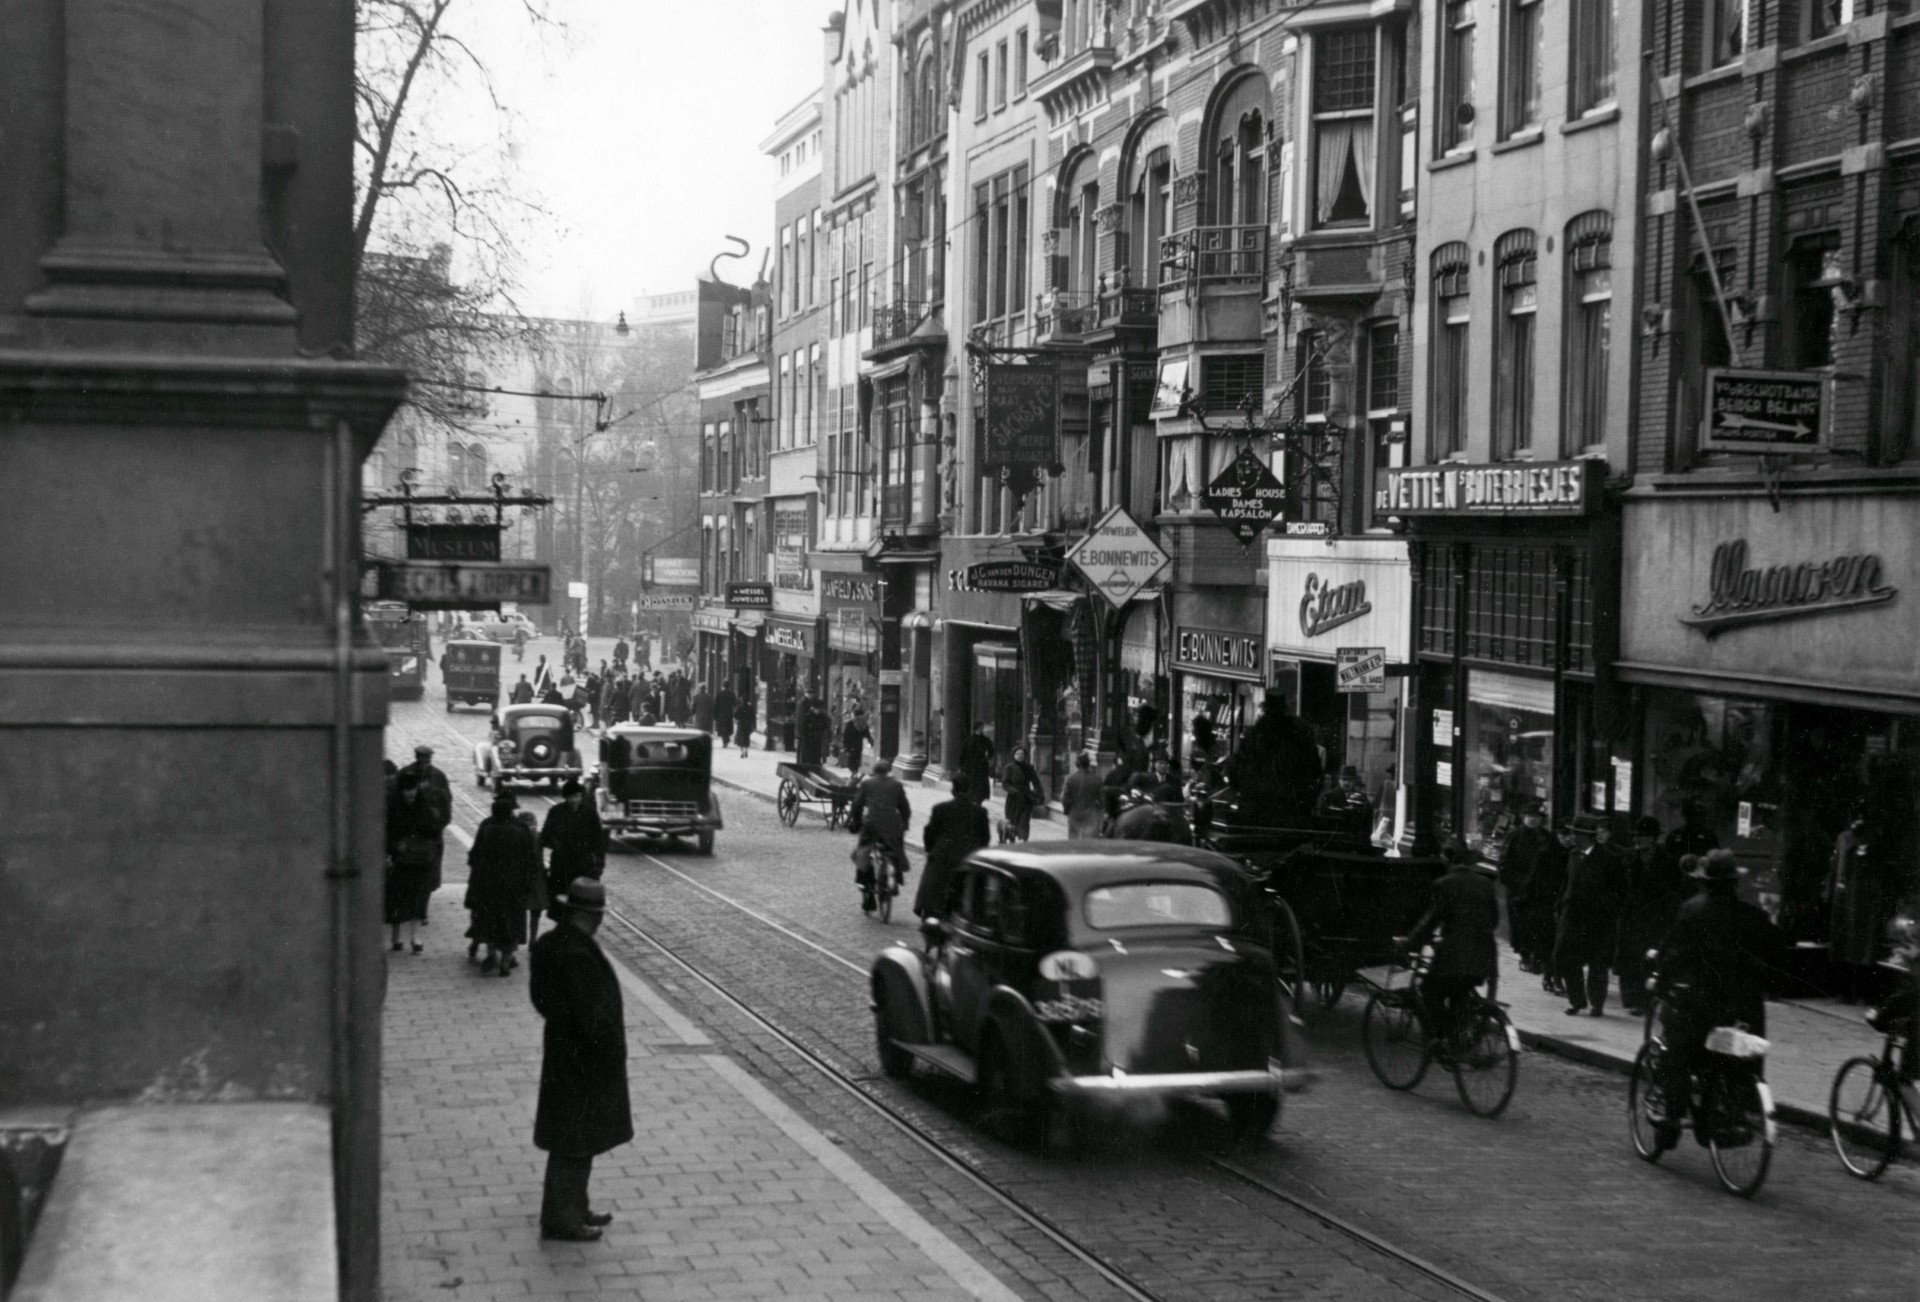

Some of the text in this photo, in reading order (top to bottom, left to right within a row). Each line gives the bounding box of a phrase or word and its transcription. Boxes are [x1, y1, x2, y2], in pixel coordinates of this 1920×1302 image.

[1718, 398, 1820, 415] BEIDER BELANG
[1209, 487, 1286, 499] LADIES HOUSE
[1376, 490, 1388, 508] DE
[1465, 466, 1581, 504] BOTERBIESJES
[1232, 499, 1263, 509] DAMES
[1220, 508, 1272, 519] KAPSALON
[1099, 526, 1138, 537] JUWELIER
[413, 536, 497, 557] MUSEUM
[1079, 550, 1159, 567] E.BONNEWITS
[1013, 565, 1057, 581] DUNGEN
[977, 579, 1050, 588] HAVANA SIGAREN
[1300, 572, 1372, 637] Etam
